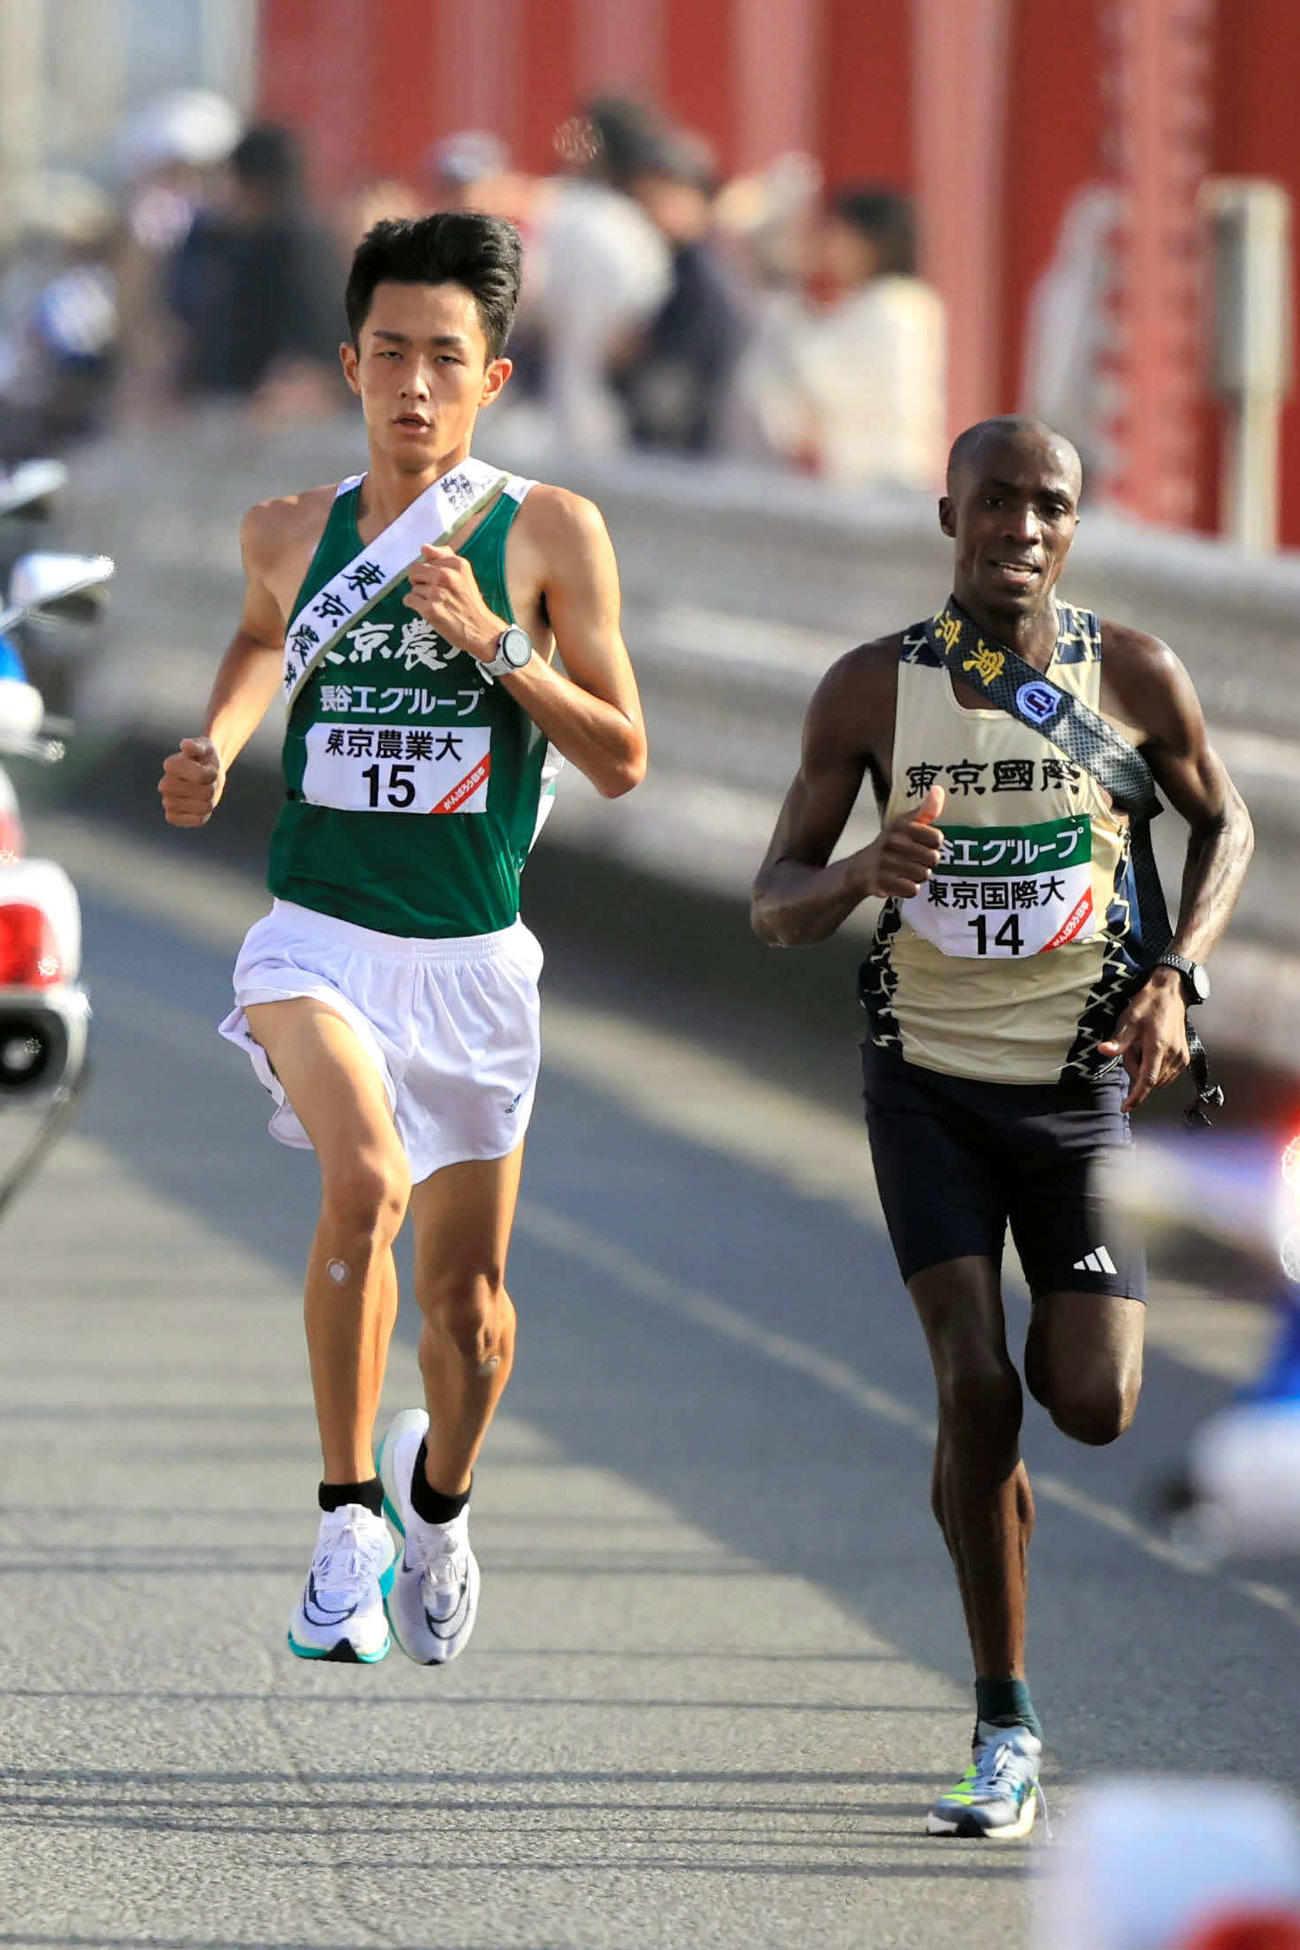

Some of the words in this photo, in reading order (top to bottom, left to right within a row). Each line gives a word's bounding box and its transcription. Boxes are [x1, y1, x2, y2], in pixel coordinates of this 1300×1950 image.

[318, 618, 461, 671] 京農
[320, 685, 485, 716] 長谷工グループ
[325, 728, 463, 761] 東京農業大
[362, 764, 416, 808] 15
[928, 875, 1065, 910] 東京国際大
[968, 914, 1024, 955] 14
